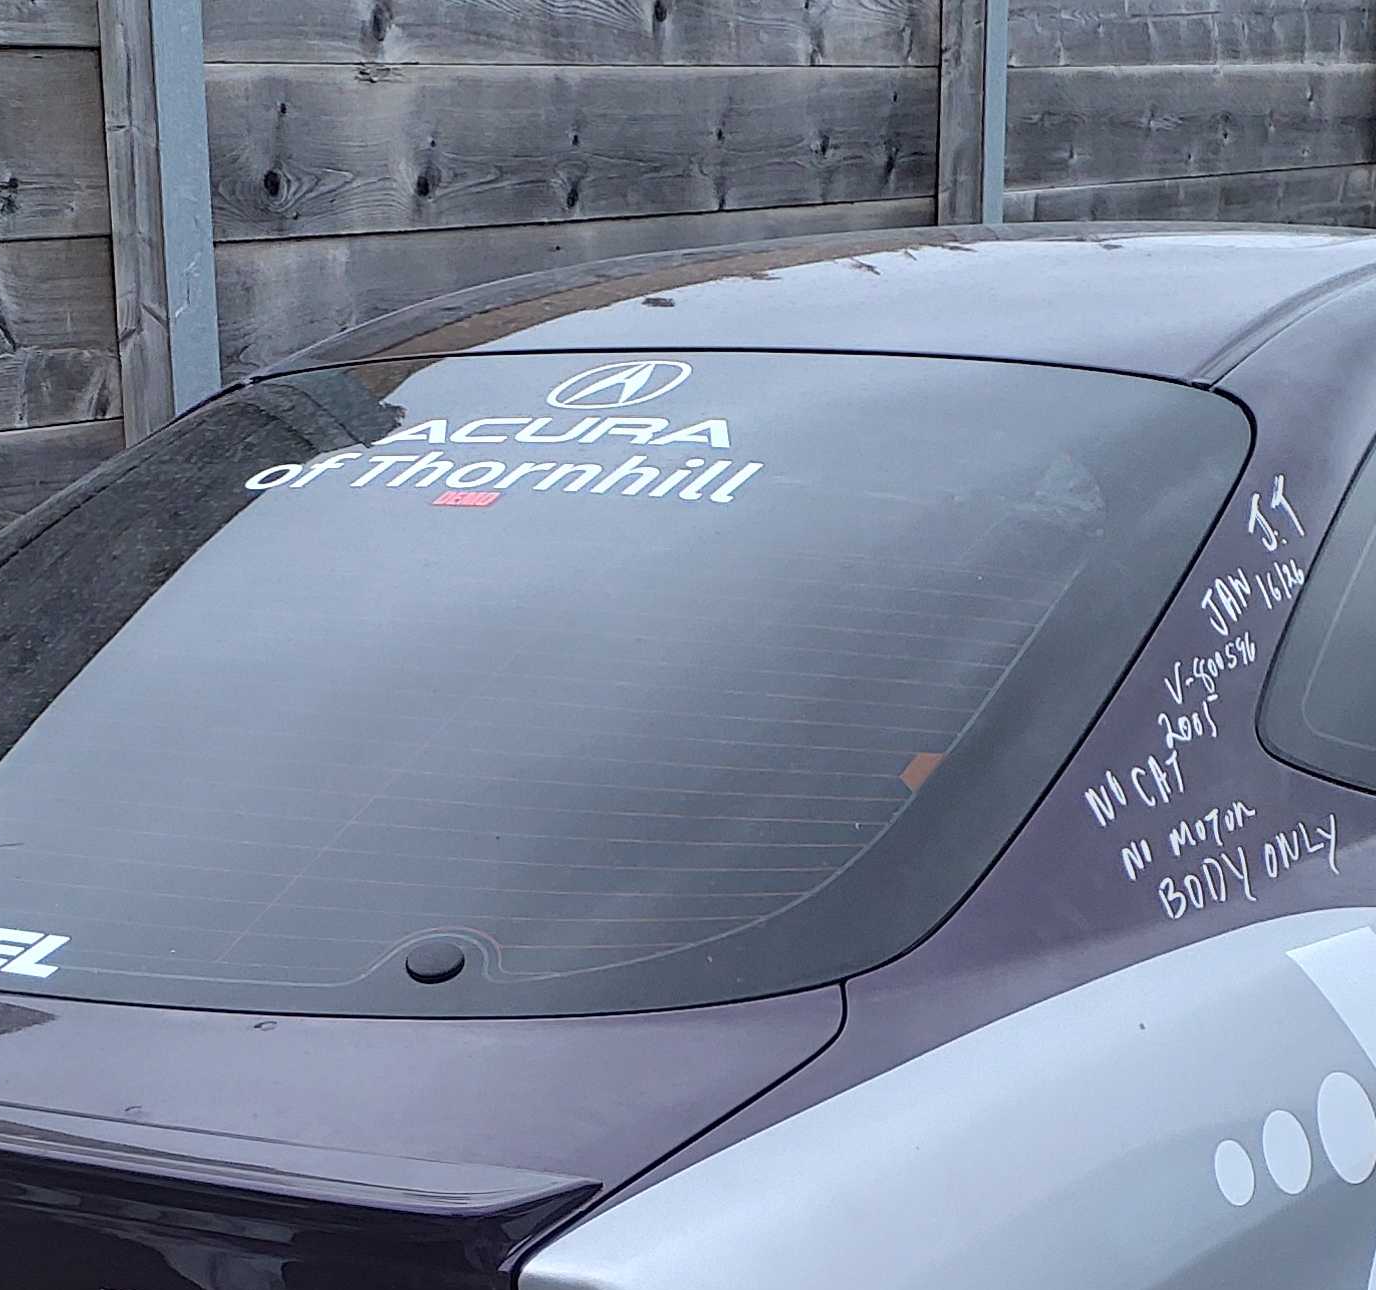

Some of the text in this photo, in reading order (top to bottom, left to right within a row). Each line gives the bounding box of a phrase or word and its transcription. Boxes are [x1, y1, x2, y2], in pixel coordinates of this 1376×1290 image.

[372, 416, 731, 448] ACURA
[244, 450, 764, 503] of Thornhill
[1201, 567, 1252, 636] JAN
[1084, 750, 1185, 827] NO CAT
[1158, 813, 1341, 919] BODY ONLY
